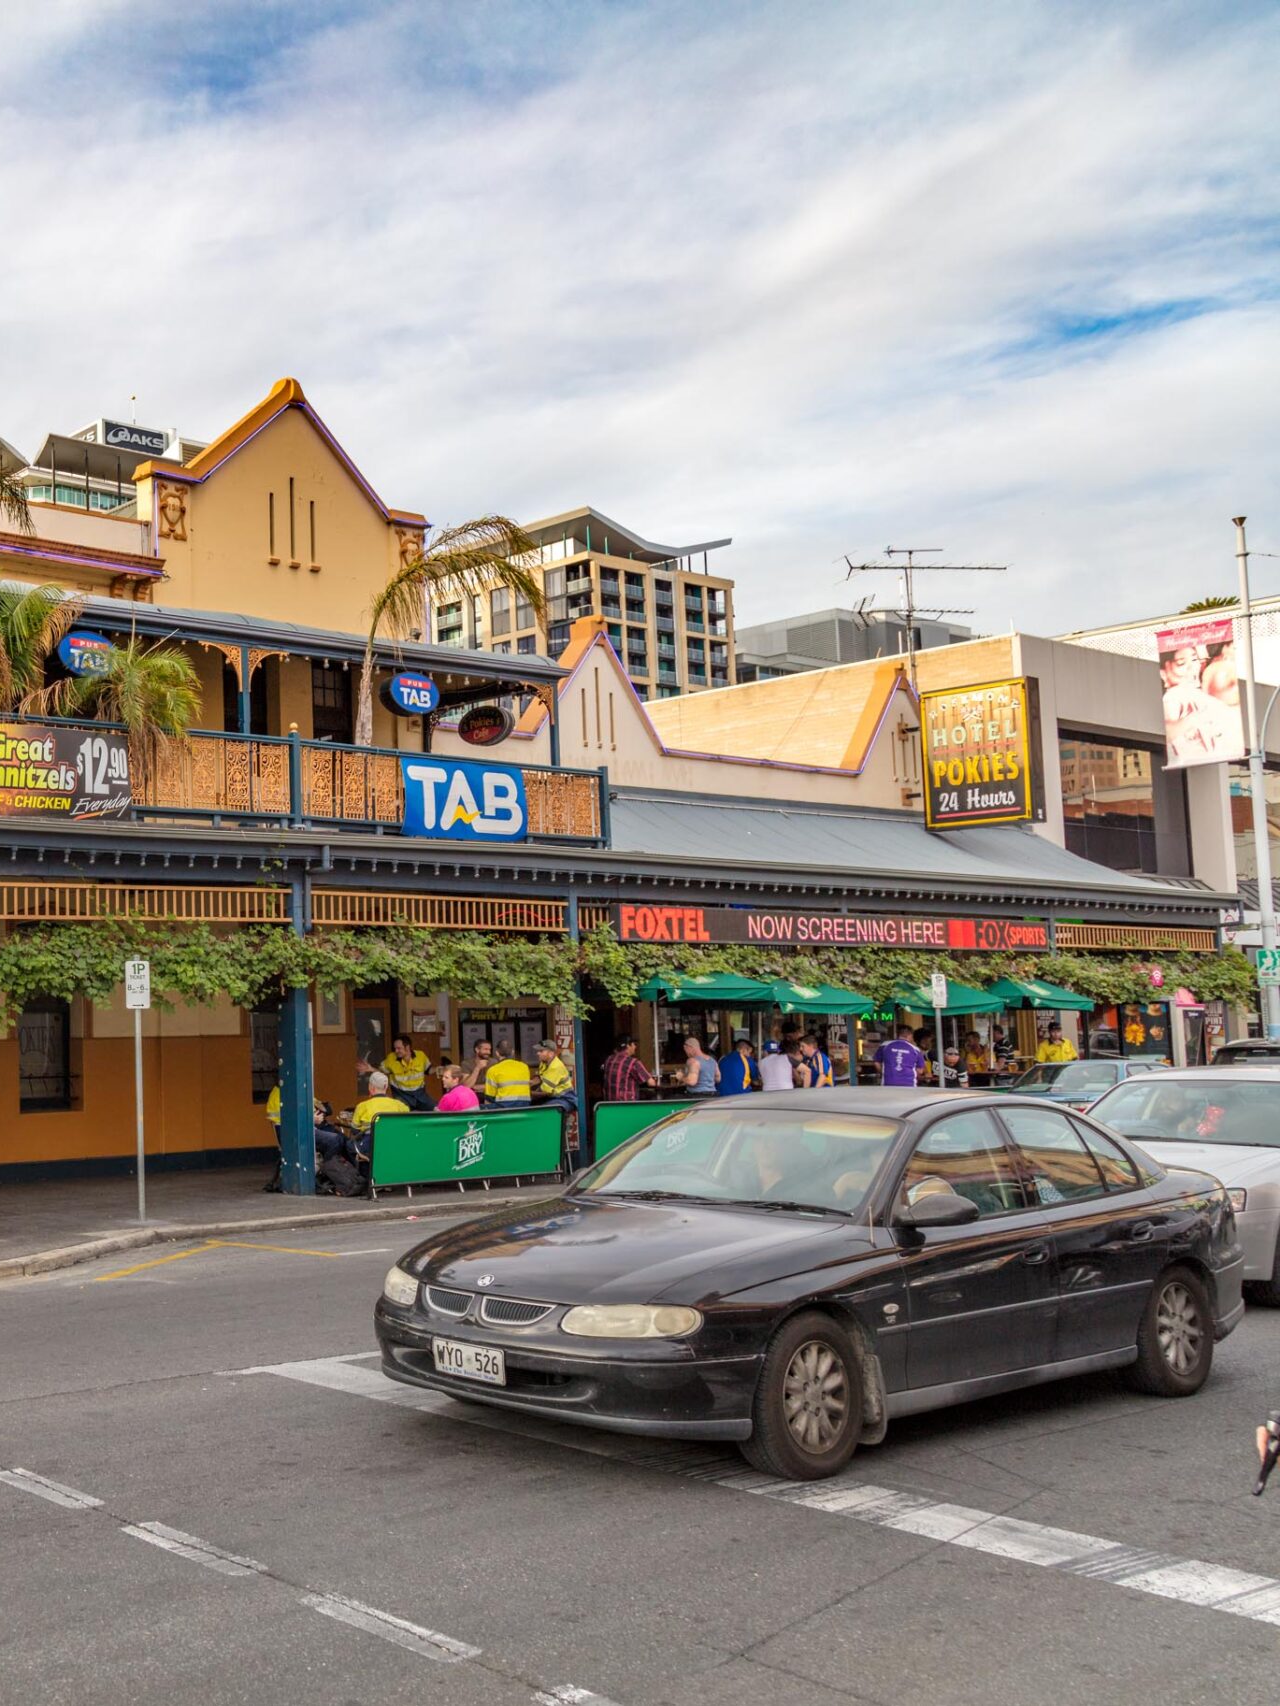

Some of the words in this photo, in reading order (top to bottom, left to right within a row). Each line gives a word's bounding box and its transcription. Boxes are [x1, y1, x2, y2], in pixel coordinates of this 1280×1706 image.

[107, 427, 164, 448] OAKS
[400, 687, 431, 708] TAB
[932, 720, 1017, 747] HOTEL
[76, 737, 128, 795] $12.90
[933, 751, 1020, 789] POKIES
[14, 794, 71, 810] CHICKEN
[70, 792, 131, 818] Everyday
[406, 765, 523, 836] TAB
[939, 792, 959, 812] 24
[967, 788, 1016, 810] Hours
[621, 907, 710, 942] FOXTEL
[748, 915, 793, 940] NOW
[797, 918, 898, 944] SCREENING
[901, 921, 945, 946] HERE
[975, 922, 1010, 948] FOX
[1010, 925, 1047, 947] SPORTS
[131, 963, 145, 975] 1P
[459, 1131, 483, 1147] EXTRA
[459, 1140, 481, 1161] DRY
[436, 1344, 464, 1367] WYO
[475, 1352, 499, 1375] 526
